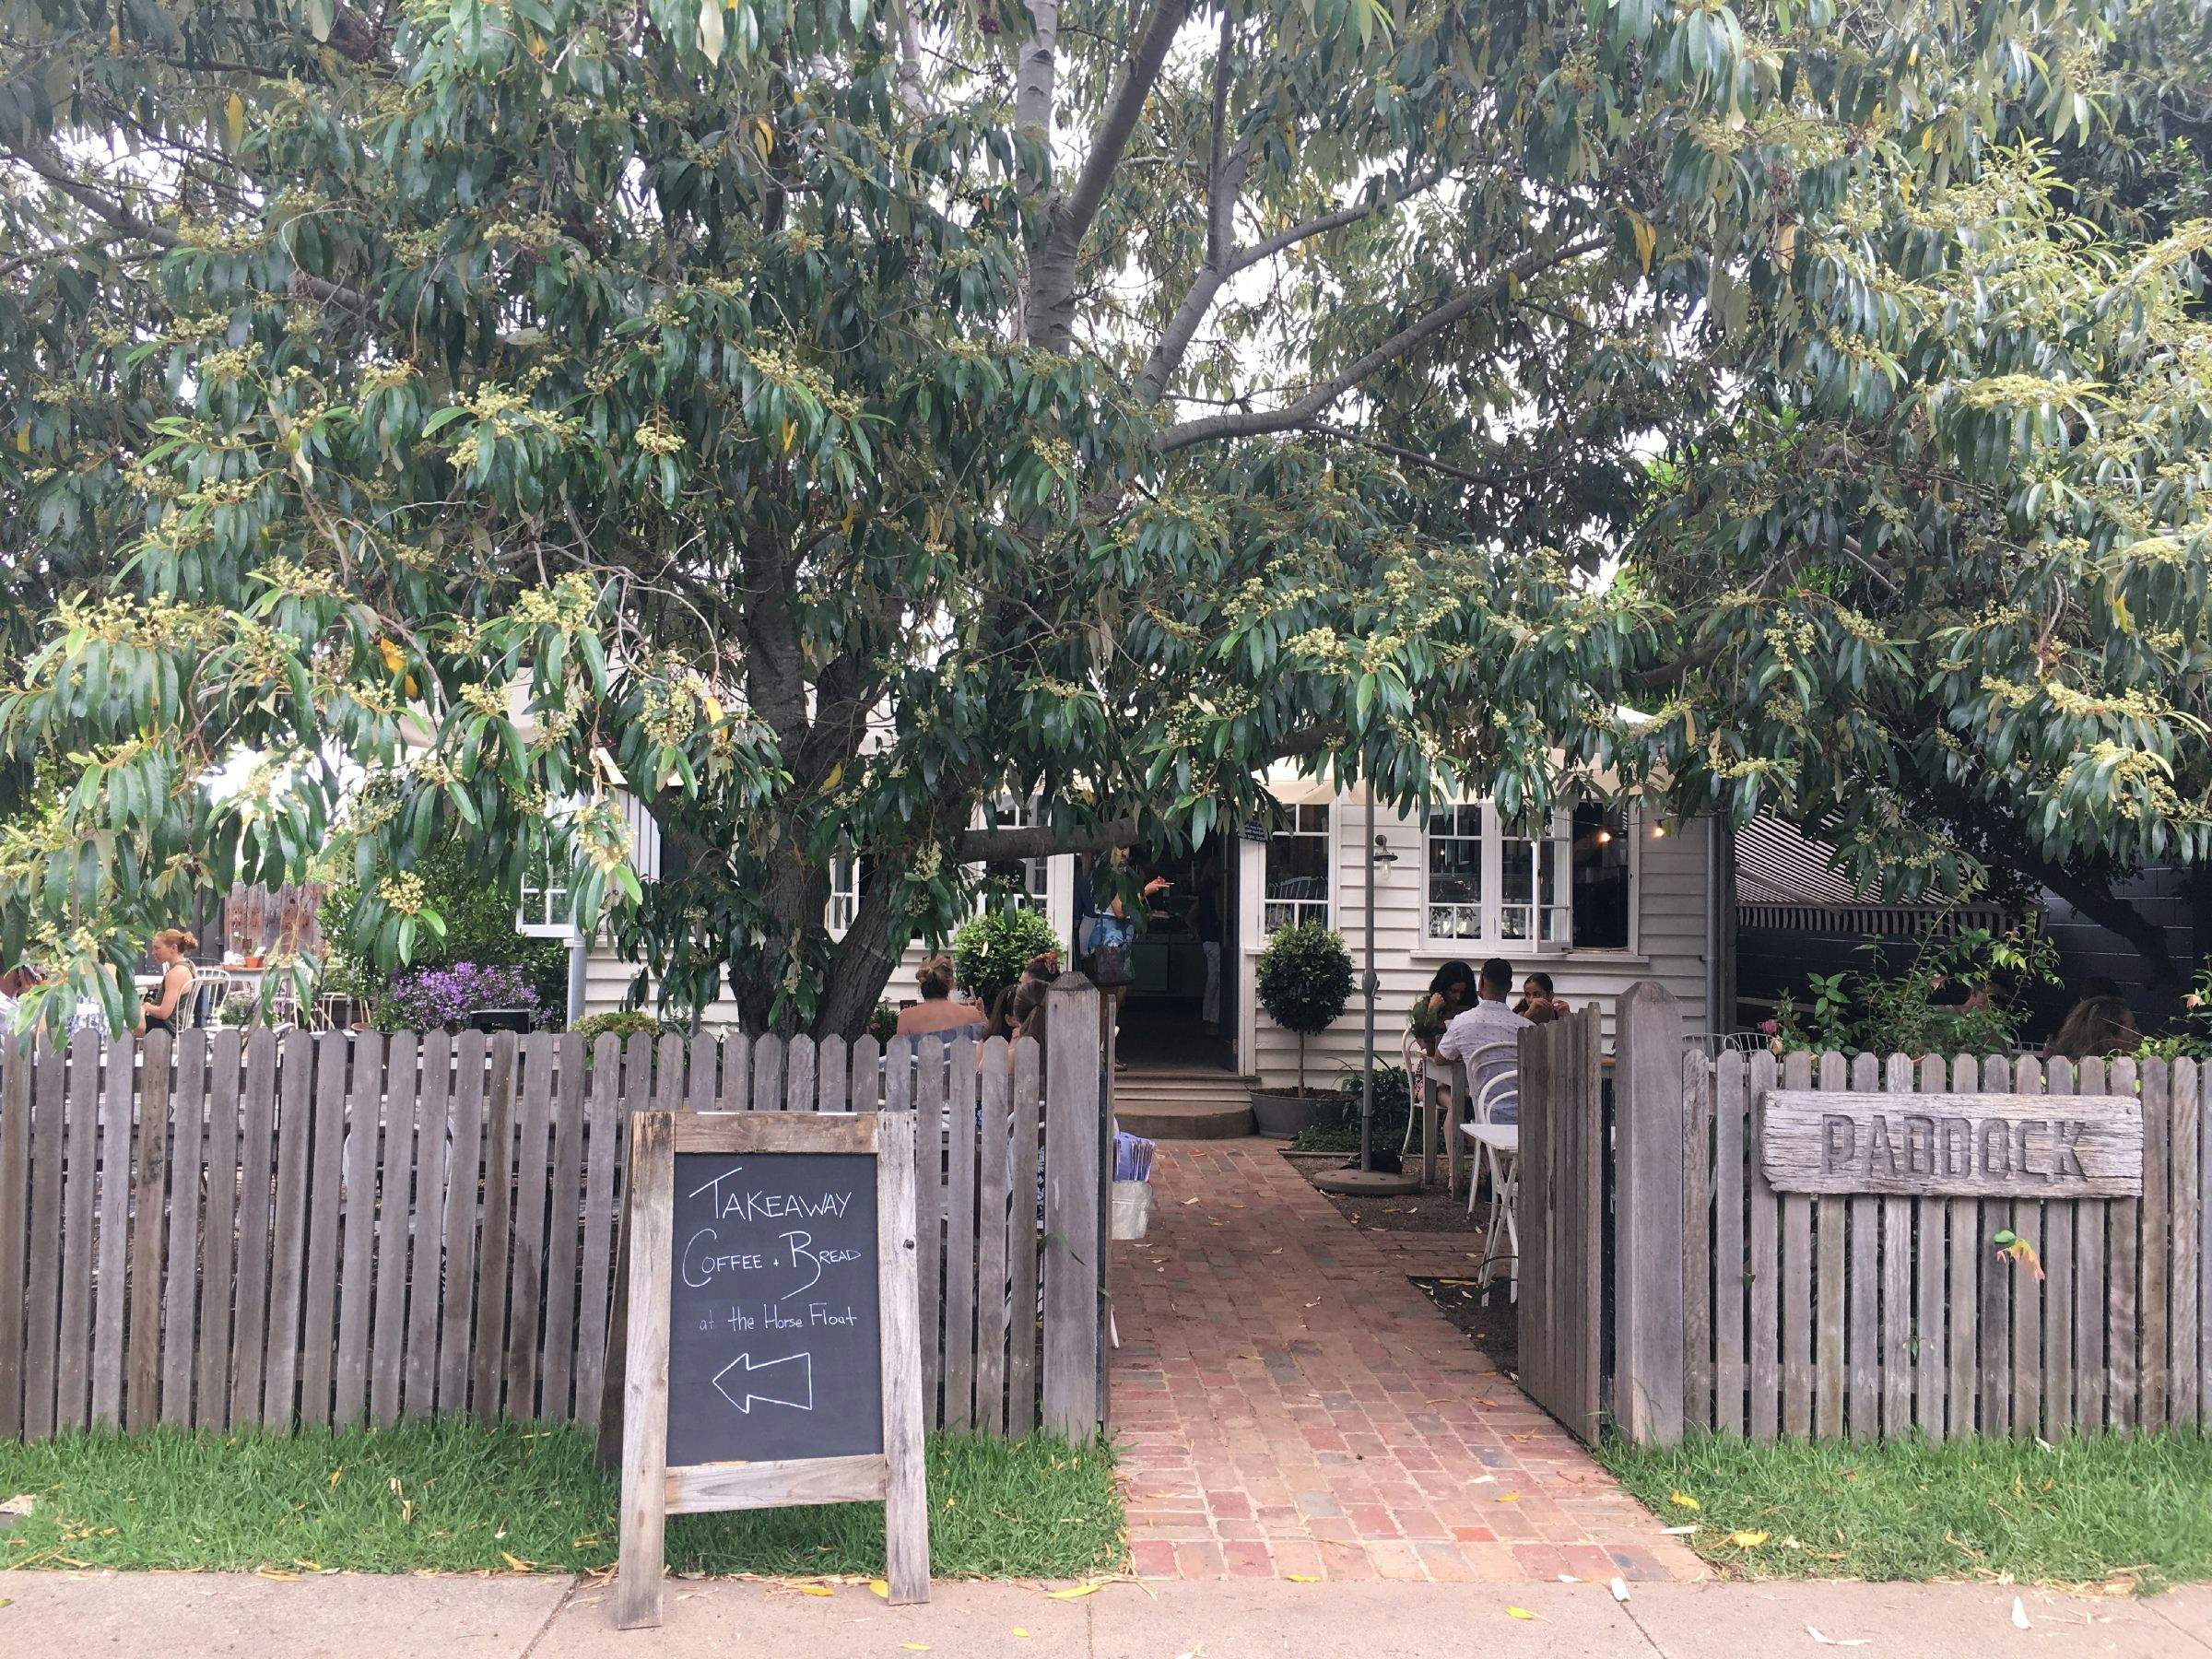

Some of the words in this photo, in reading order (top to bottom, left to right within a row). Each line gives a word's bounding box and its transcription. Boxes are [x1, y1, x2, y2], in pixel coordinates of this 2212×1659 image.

[1819, 1113, 2088, 1183] PADDOCK
[688, 1166, 852, 1222] TAKEAWAY
[682, 1228, 762, 1288] COFFEE
[779, 1230, 862, 1300] BREAD
[700, 1309, 715, 1331] at
[727, 1305, 755, 1332] the
[763, 1303, 804, 1329] Horse
[808, 1302, 857, 1326] Float
